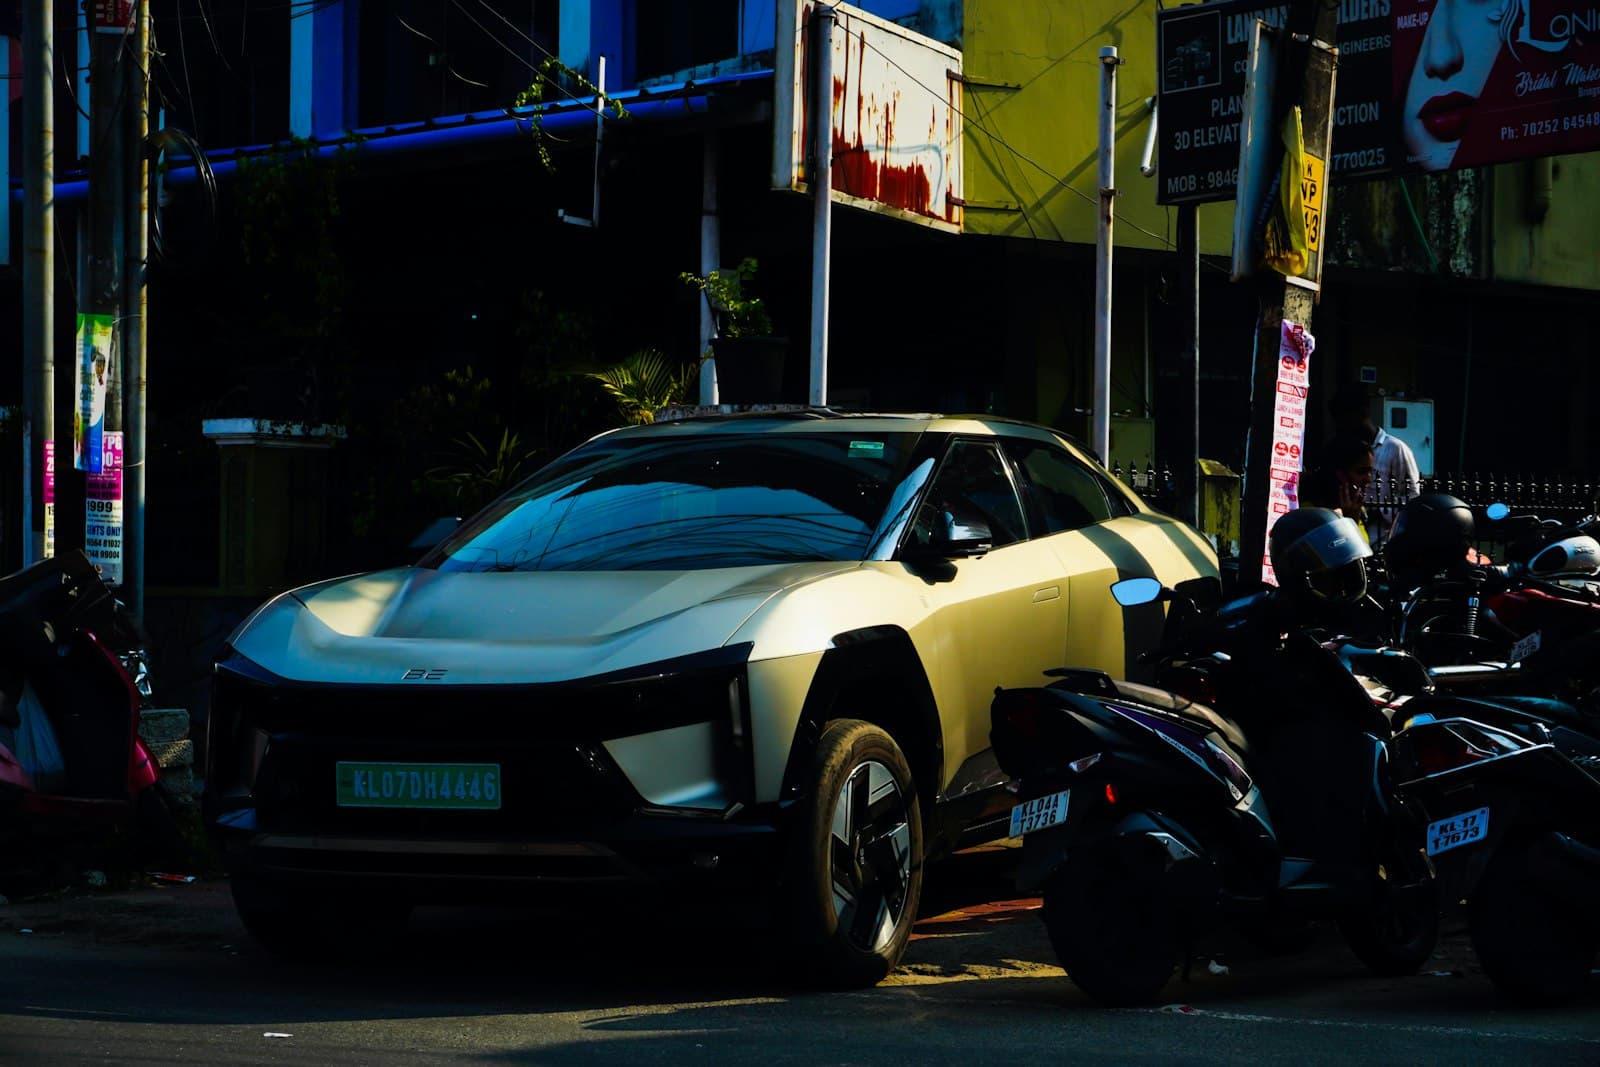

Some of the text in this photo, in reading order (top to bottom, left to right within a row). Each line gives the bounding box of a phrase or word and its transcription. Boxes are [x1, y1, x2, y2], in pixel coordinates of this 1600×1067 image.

[1396, 11, 1430, 31] MAKE-UP
[1515, 70, 1558, 97] Bridal
[1522, 118, 1560, 137] 70252
[1174, 130, 1191, 151] 3D
[1167, 174, 1197, 194] MOB
[401, 668, 449, 680] BE
[353, 769, 496, 801] KL07DH4446
